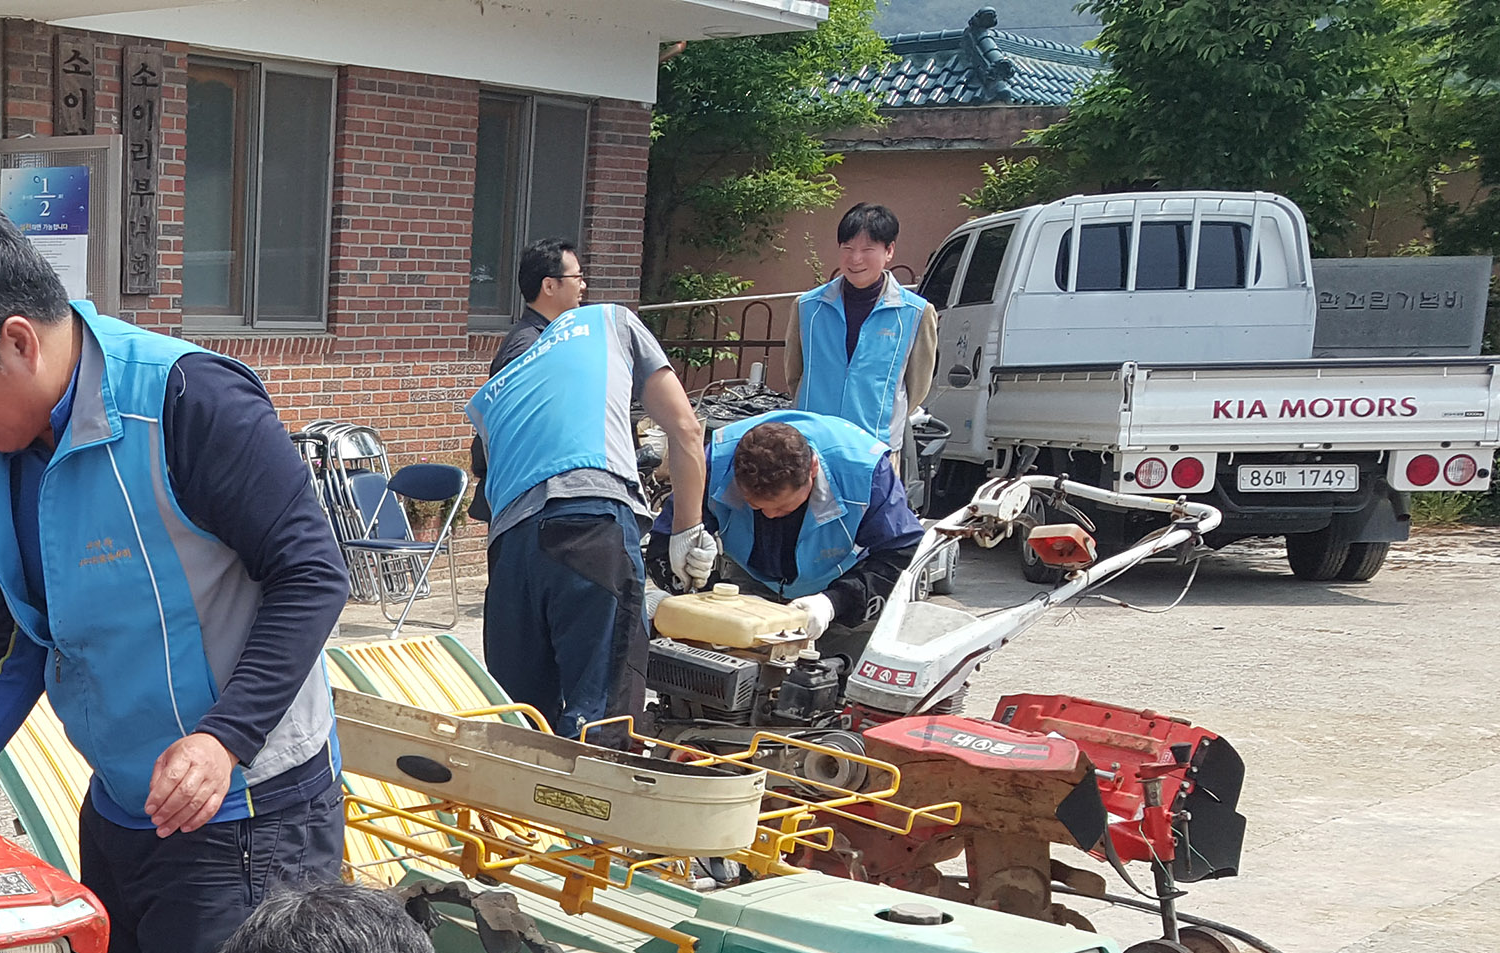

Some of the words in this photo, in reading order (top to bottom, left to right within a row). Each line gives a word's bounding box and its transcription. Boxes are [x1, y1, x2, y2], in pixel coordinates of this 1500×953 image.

[62, 49, 92, 136] 소이
[129, 62, 160, 284] 소이리부녀회
[1212, 399, 1268, 419] KIA
[1278, 396, 1419, 418] MOTORS
[1250, 470, 1288, 487] 86마
[1299, 469, 1346, 486] 1749
